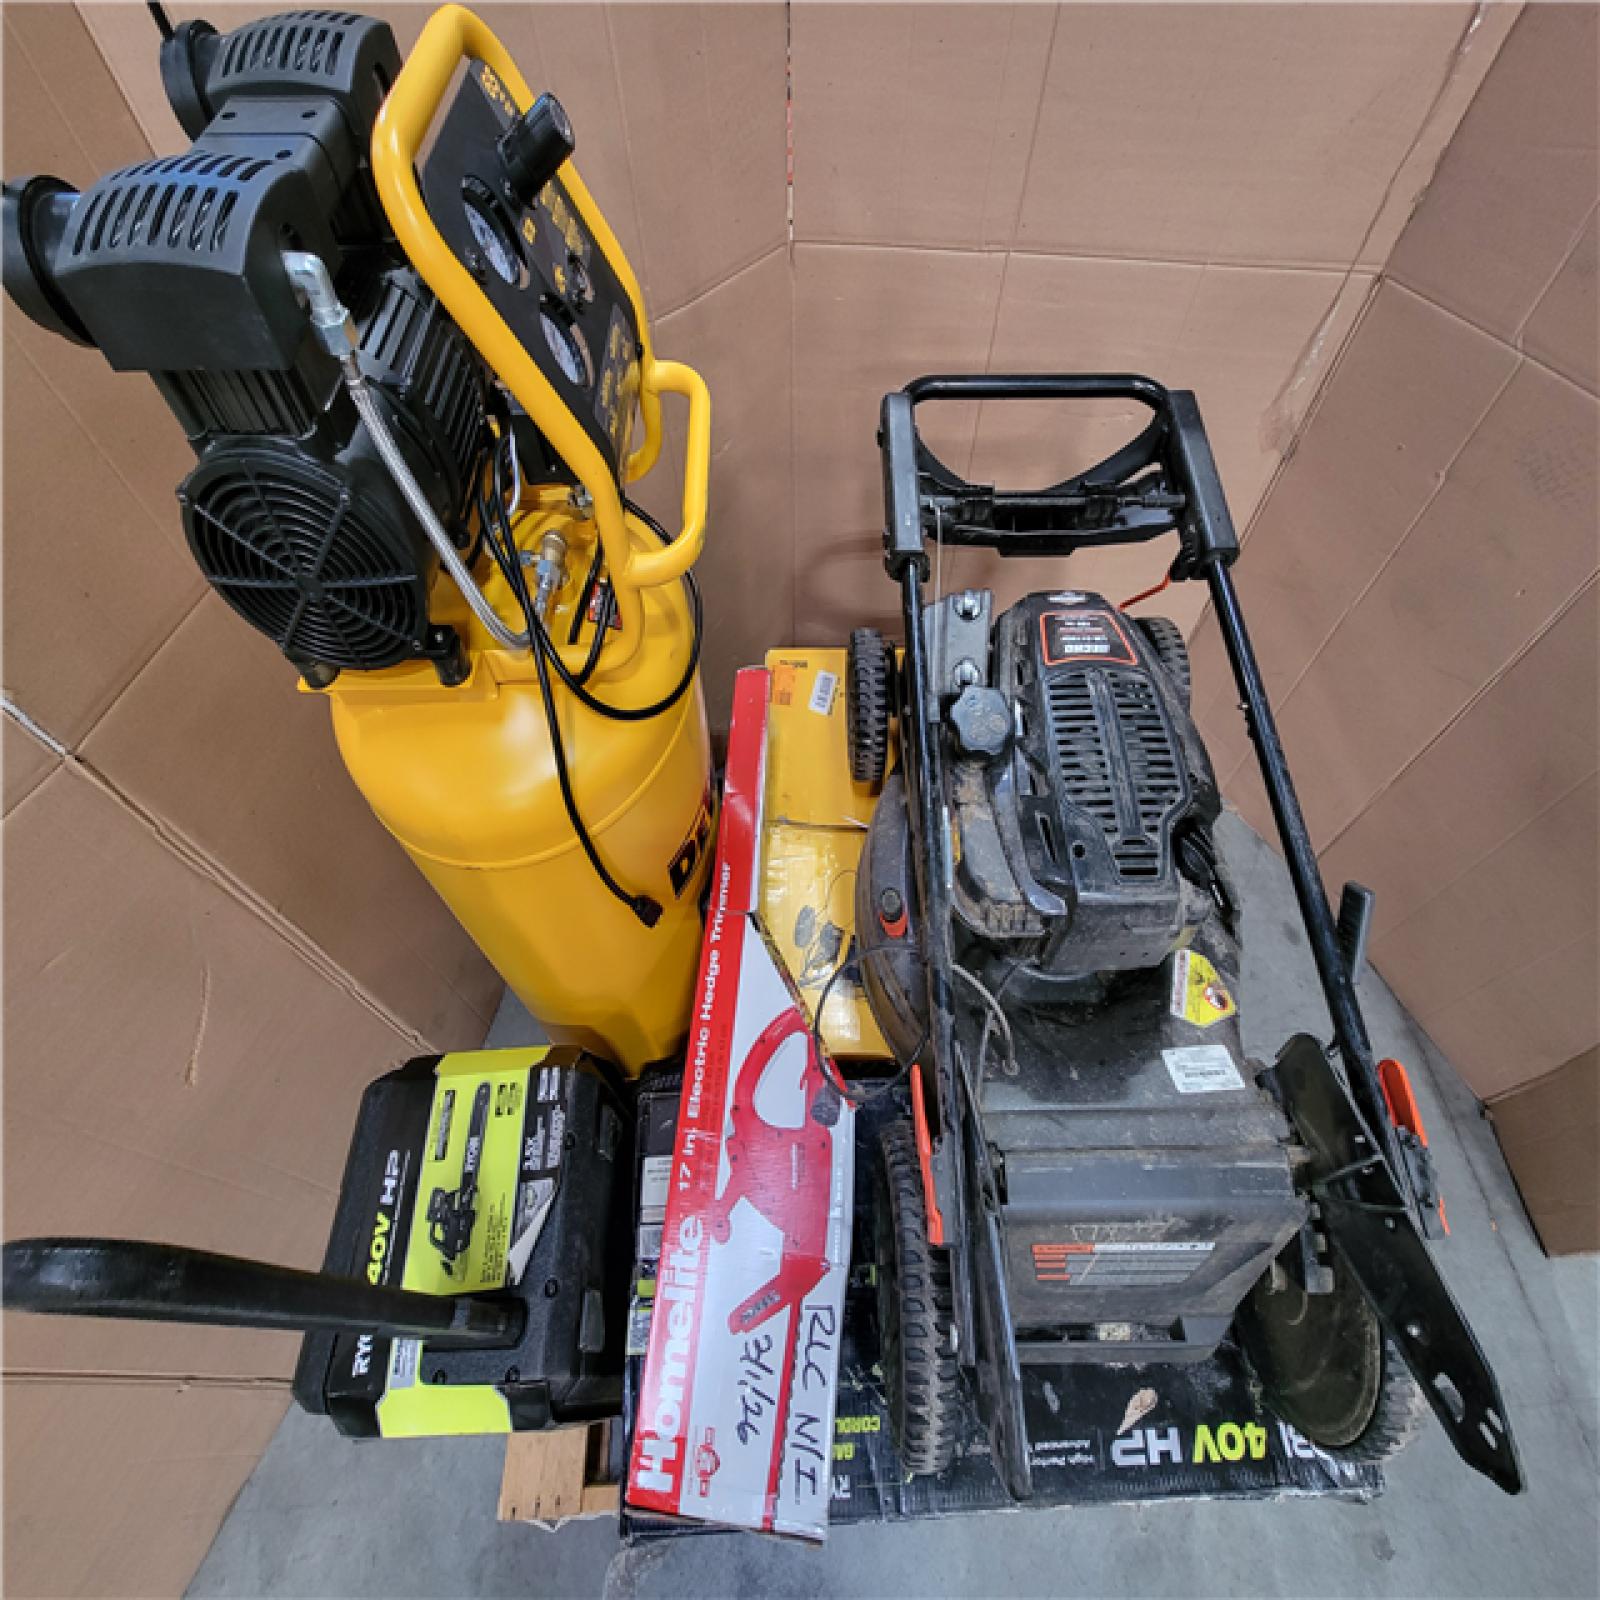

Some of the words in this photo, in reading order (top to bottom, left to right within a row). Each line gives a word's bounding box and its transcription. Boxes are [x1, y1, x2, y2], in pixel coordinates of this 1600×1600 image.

[679, 1162, 693, 1191] 17
[687, 1026, 711, 1118] Electric
[700, 949, 720, 1021] Hedge
[710, 862, 732, 943] Trimmer
[366, 1212, 392, 1286] 40V
[380, 1149, 399, 1206] HP
[637, 1215, 704, 1492] Homelite
[1111, 1427, 1181, 1467] HP
[1193, 1421, 1267, 1464] 40V
